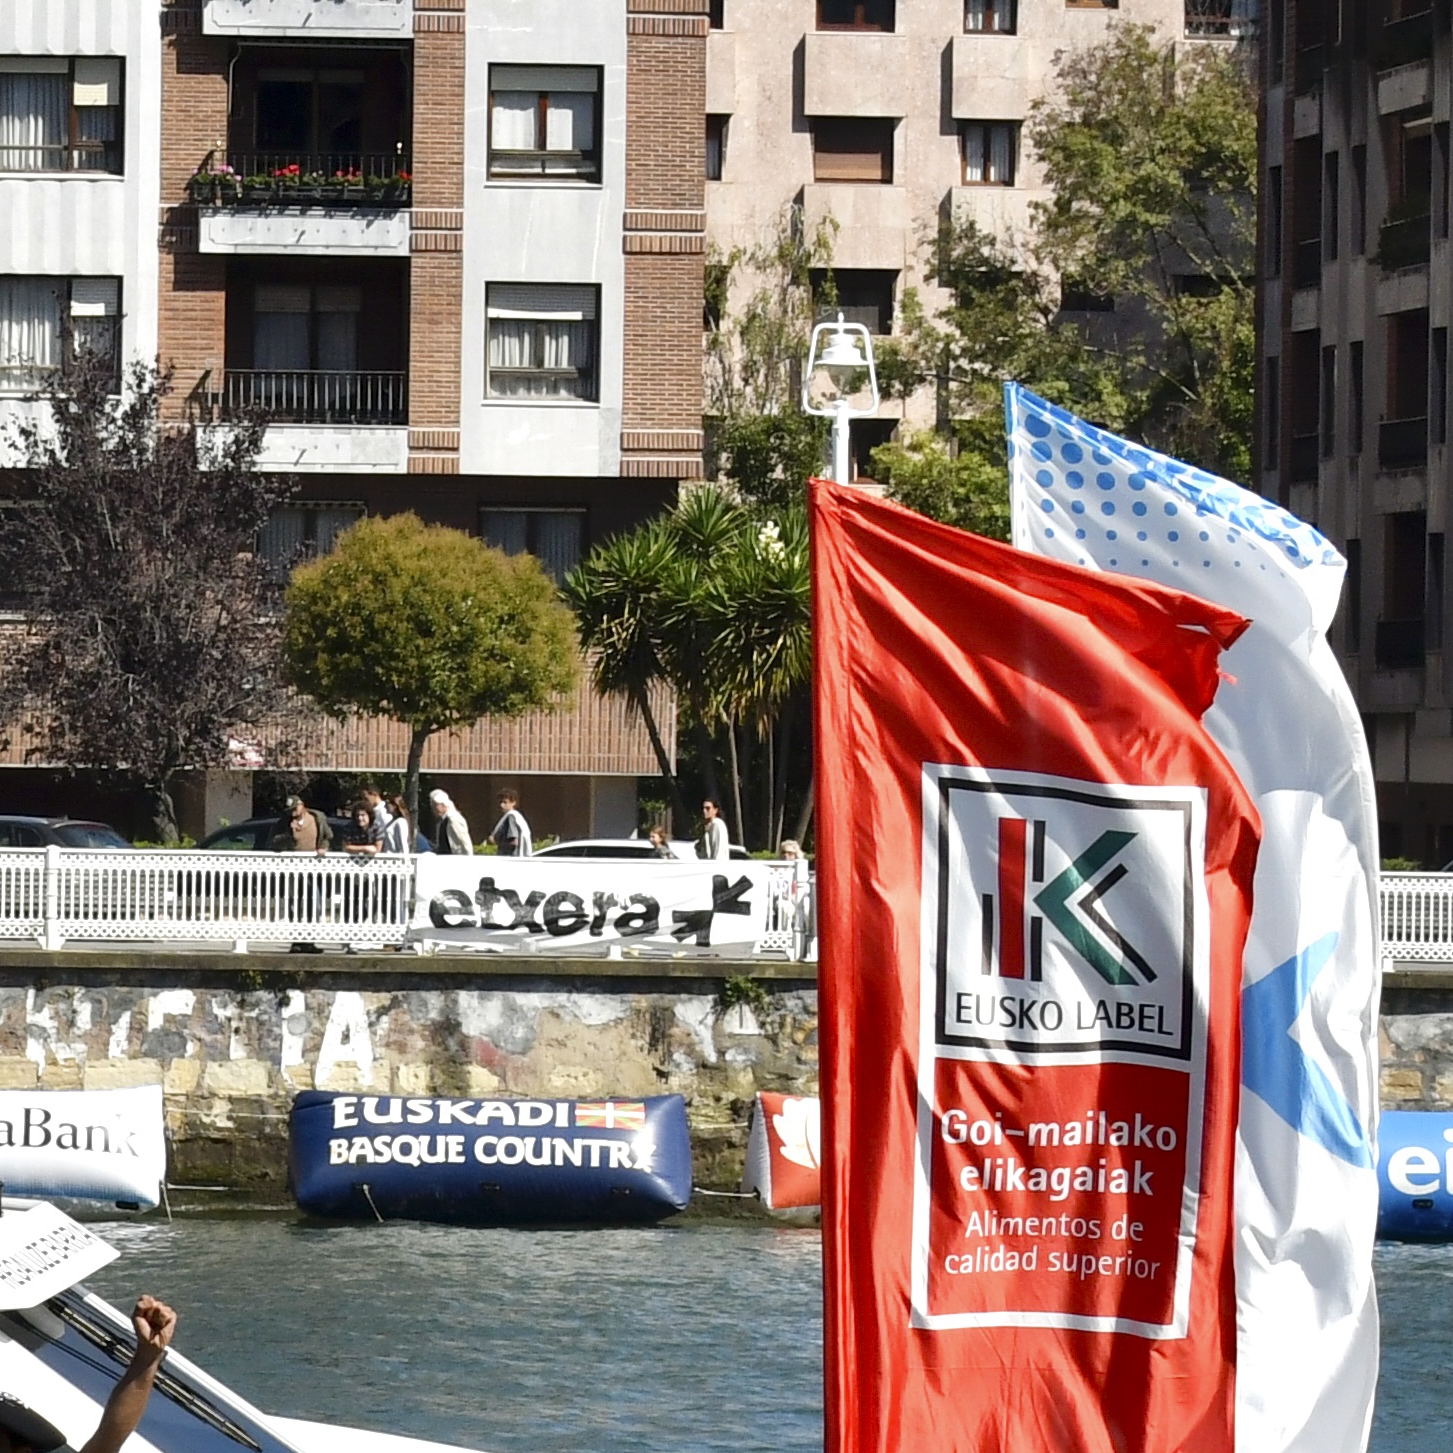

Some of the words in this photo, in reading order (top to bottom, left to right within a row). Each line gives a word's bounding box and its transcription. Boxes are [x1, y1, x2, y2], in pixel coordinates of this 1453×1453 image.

[956, 992, 1064, 1032] EUSKO
[1075, 999, 1175, 1036] LABEL
[332, 1098, 570, 1129] EUSKADI
[941, 1108, 1177, 1151] Goi-mailako
[329, 1133, 466, 1167] BASQUE
[474, 1135, 657, 1173] COUNTRY
[959, 1157, 1154, 1203] elikagaiak
[965, 1209, 1102, 1241] Alimentos
[1111, 1212, 1144, 1243] de
[944, 1244, 1037, 1275] calidad
[1047, 1248, 1162, 1282] superior
